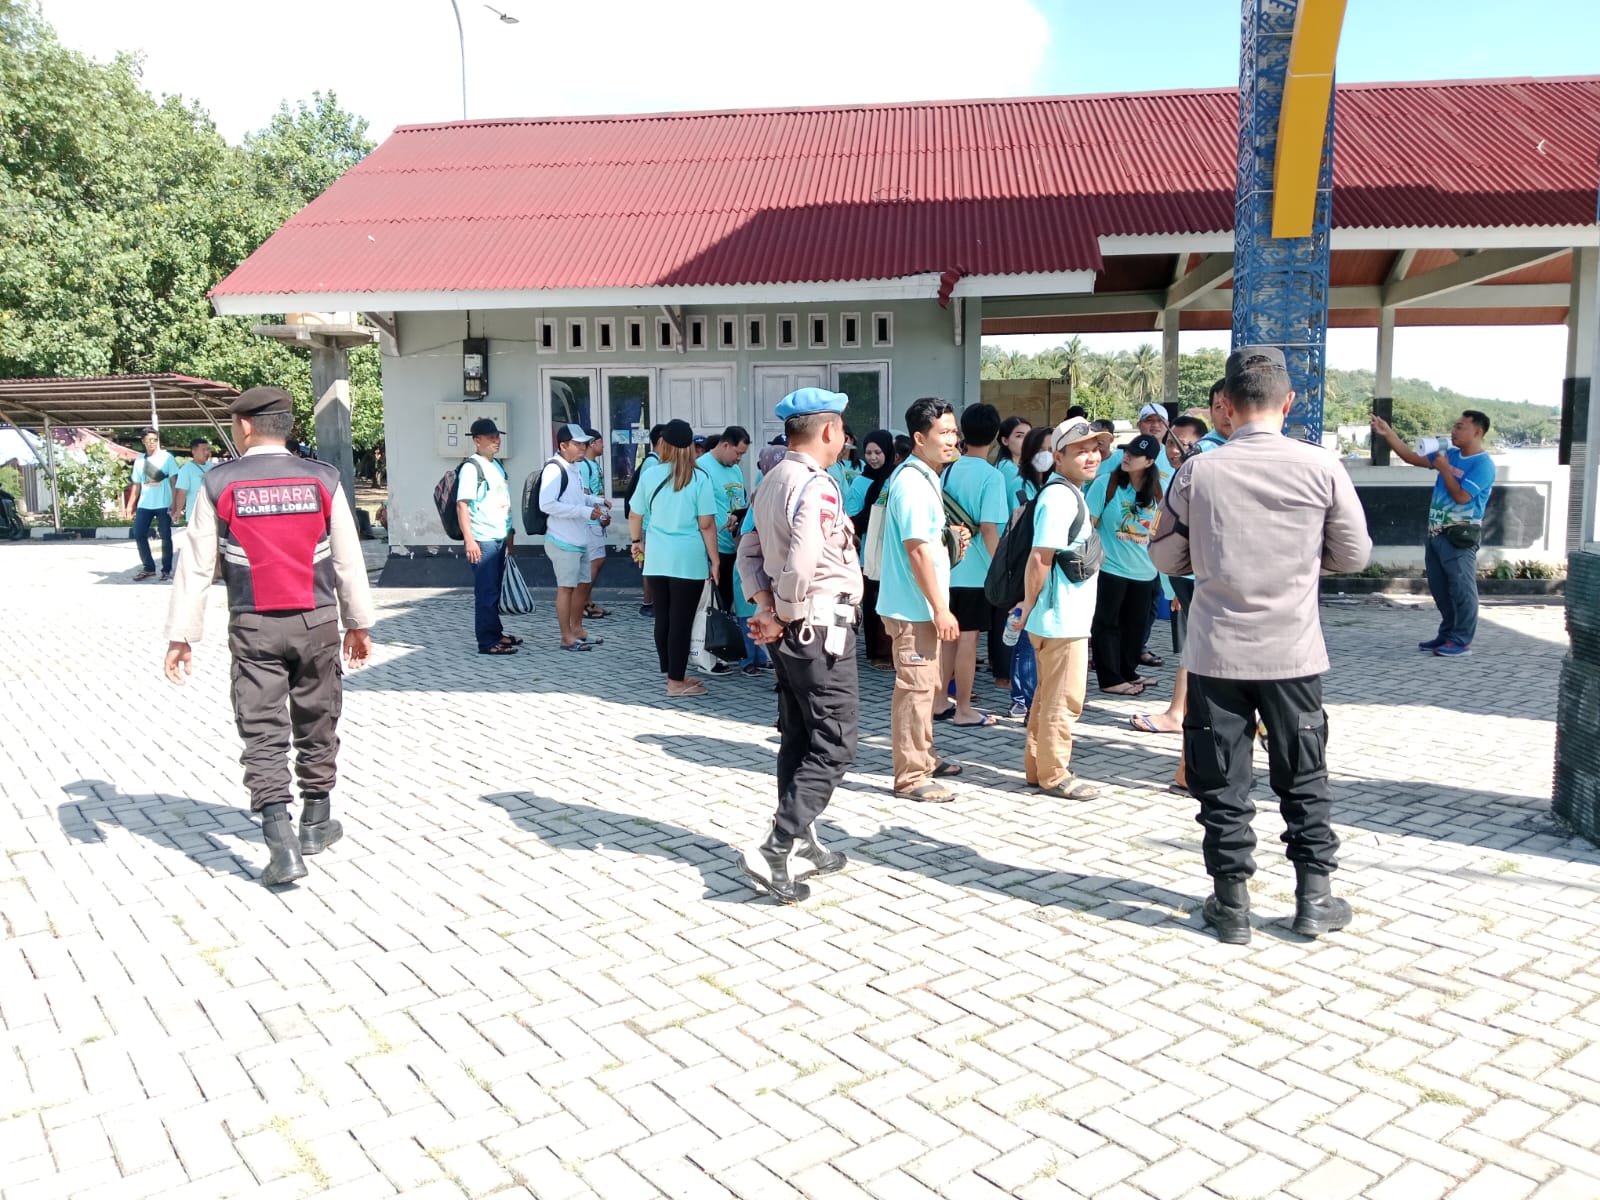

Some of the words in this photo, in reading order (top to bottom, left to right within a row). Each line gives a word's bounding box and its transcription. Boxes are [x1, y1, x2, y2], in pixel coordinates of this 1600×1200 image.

[237, 487, 315, 504] SABHARA
[238, 504, 277, 514] POLRES
[282, 502, 316, 511] LOBAR
